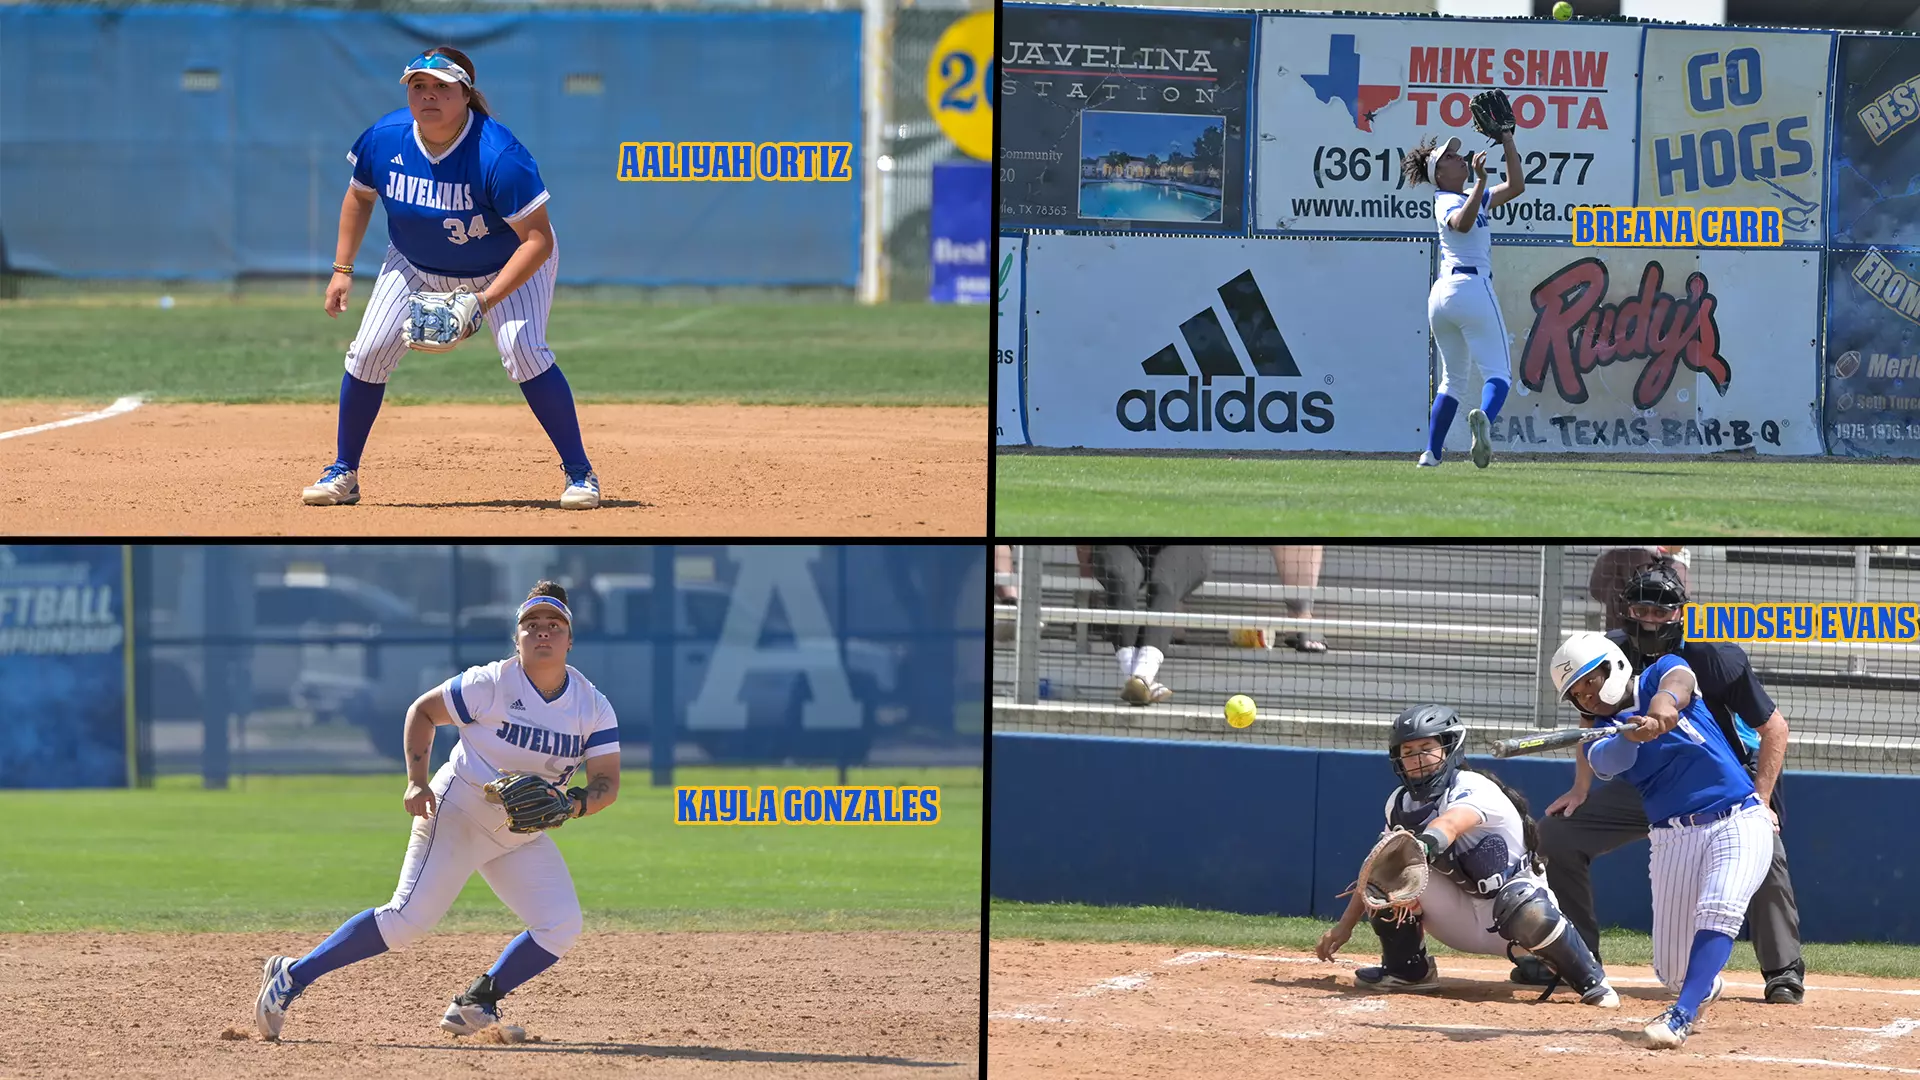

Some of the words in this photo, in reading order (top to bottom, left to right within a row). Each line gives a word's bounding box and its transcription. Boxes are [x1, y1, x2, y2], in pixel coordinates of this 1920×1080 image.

[1001, 41, 1218, 73] JAVELINA
[1408, 46, 1495, 85] MIKE
[1502, 48, 1609, 88] SHAW
[940, 51, 993, 112] 2
[1001, 79, 1214, 104] STATION
[1686, 46, 1763, 113] GO
[1407, 91, 1609, 130] TOOTA
[1000, 147, 1063, 164] Community
[1313, 146, 1406, 190] (361)
[1653, 115, 1814, 197] HOGS
[386, 170, 474, 211] JAVELINAS
[1019, 204, 1033, 214] TX
[1036, 205, 1067, 216] 78363
[442, 213, 490, 246] 34
[1519, 257, 1732, 410] Rudy's
[1866, 353, 1920, 379] Merl
[1116, 375, 1335, 434] adidas
[1487, 415, 1547, 444] EAL
[1549, 415, 1653, 447] TEXAS
[1660, 417, 1782, 447] BAR-B-Q
